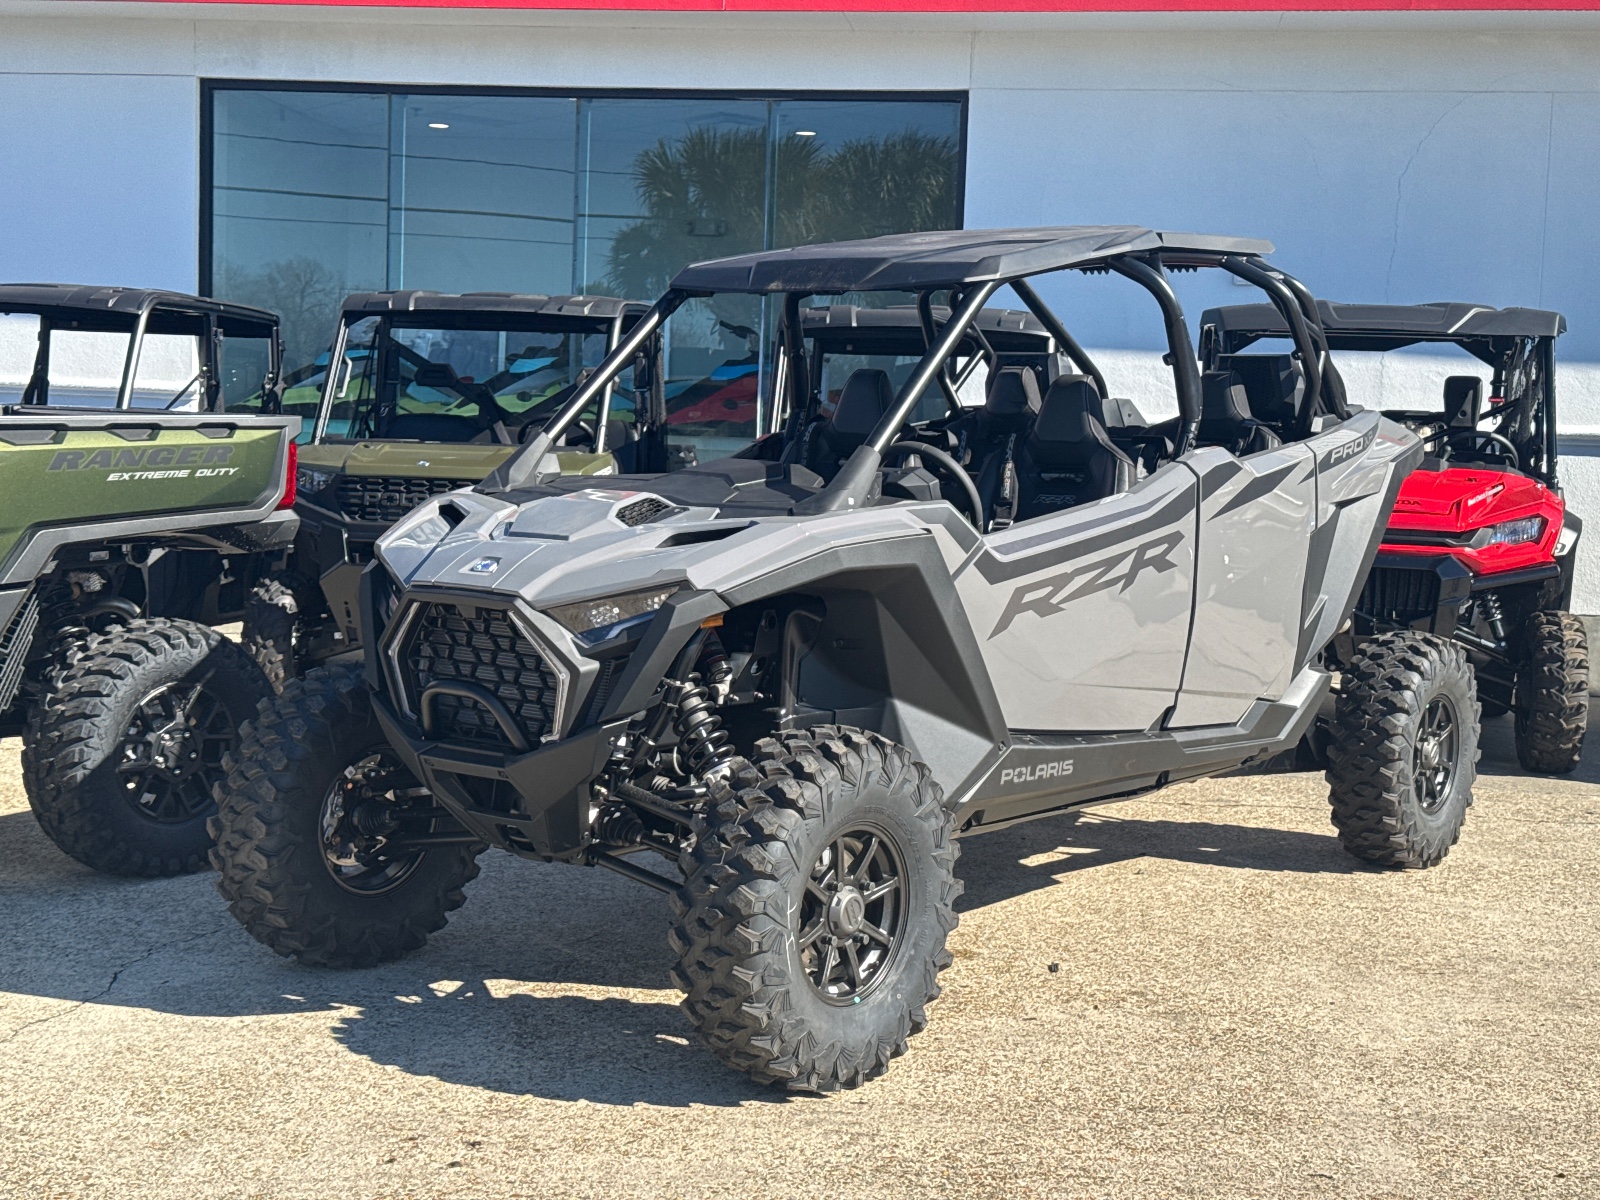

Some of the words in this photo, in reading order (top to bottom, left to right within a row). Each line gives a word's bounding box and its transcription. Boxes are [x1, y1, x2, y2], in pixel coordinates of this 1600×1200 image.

[47, 445, 236, 472] RANGER
[1330, 437, 1364, 463] PRO
[106, 469, 190, 482] EXTREME
[195, 467, 240, 477] DUTY
[986, 529, 1186, 641] RZR
[1000, 759, 1074, 785] POLARIS
